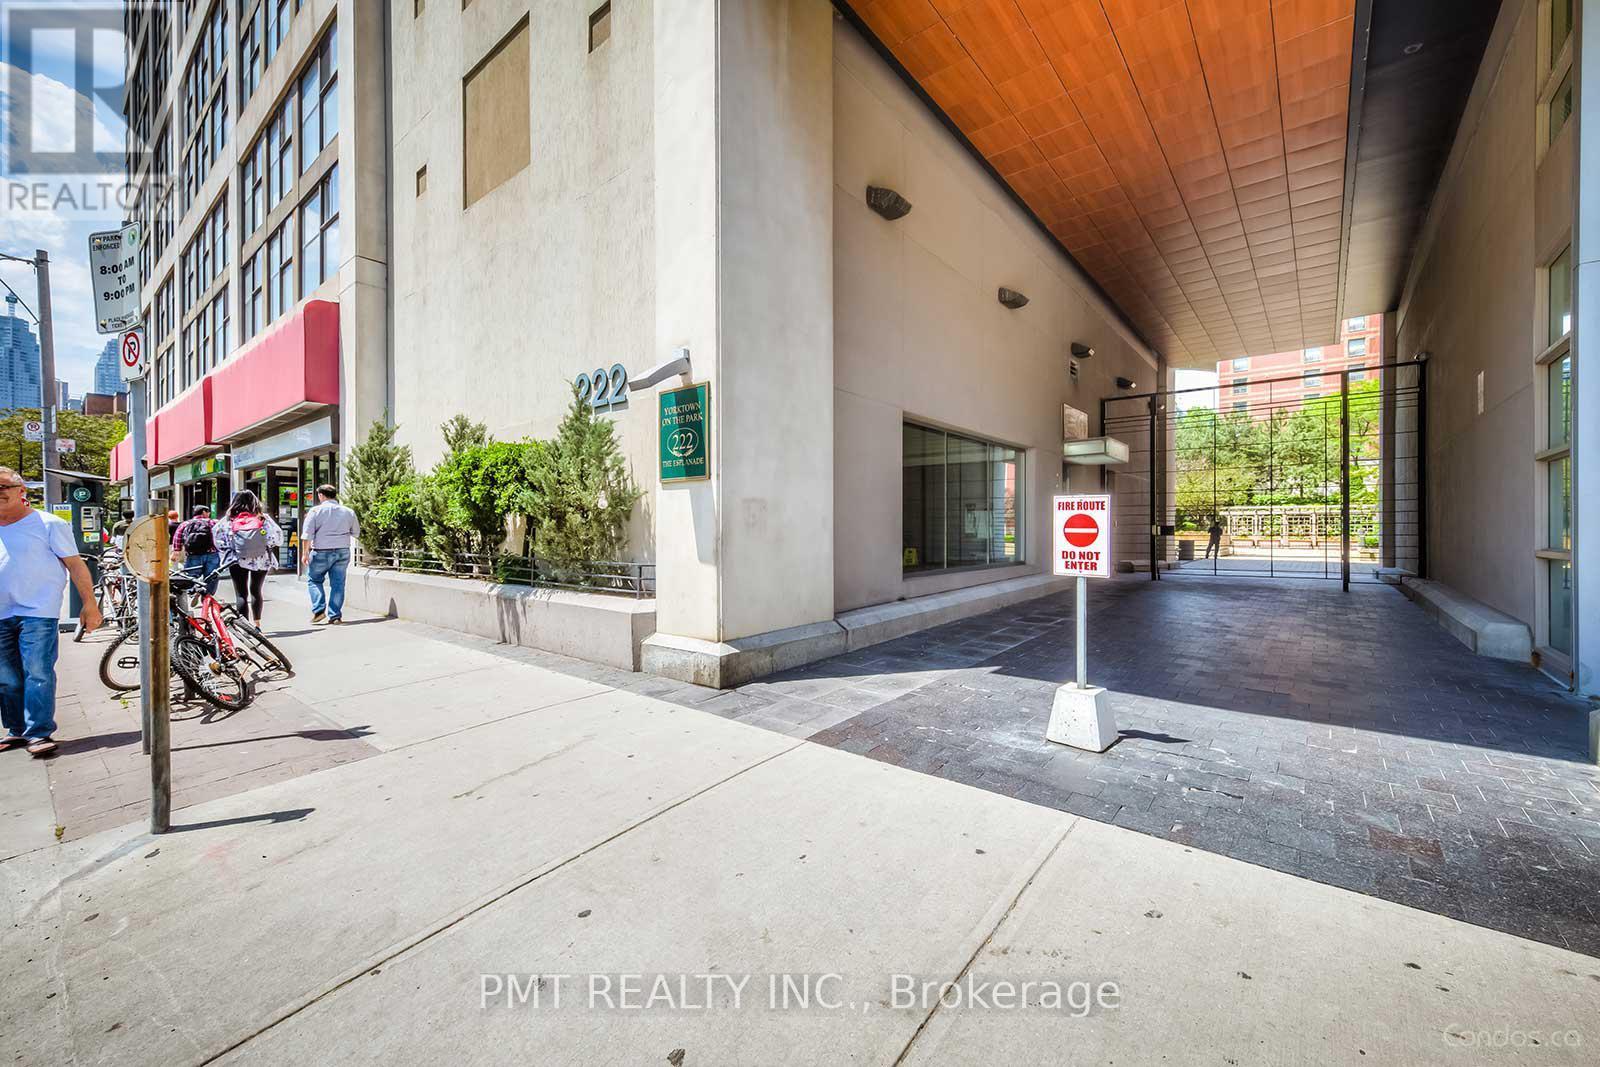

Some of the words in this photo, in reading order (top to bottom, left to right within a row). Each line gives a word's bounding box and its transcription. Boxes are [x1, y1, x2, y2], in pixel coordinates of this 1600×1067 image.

[100, 263, 123, 275] 8:00
[124, 256, 134, 269] AM
[117, 274, 126, 285] TO
[103, 289, 124, 301] 9:00
[125, 283, 135, 295] PM
[575, 363, 628, 408] 222
[664, 401, 701, 416] YORKTOWN
[662, 418, 671, 426] ON
[673, 414, 685, 424] THE
[686, 412, 703, 423] PARK
[672, 432, 693, 451] 222
[673, 457, 704, 467] ESPLANADE
[1057, 501, 1075, 511] FIRE
[1077, 501, 1106, 511] ROUTE
[1061, 551, 1076, 560] DO
[1078, 551, 1101, 561] NOT
[1064, 561, 1098, 571] ENTER
